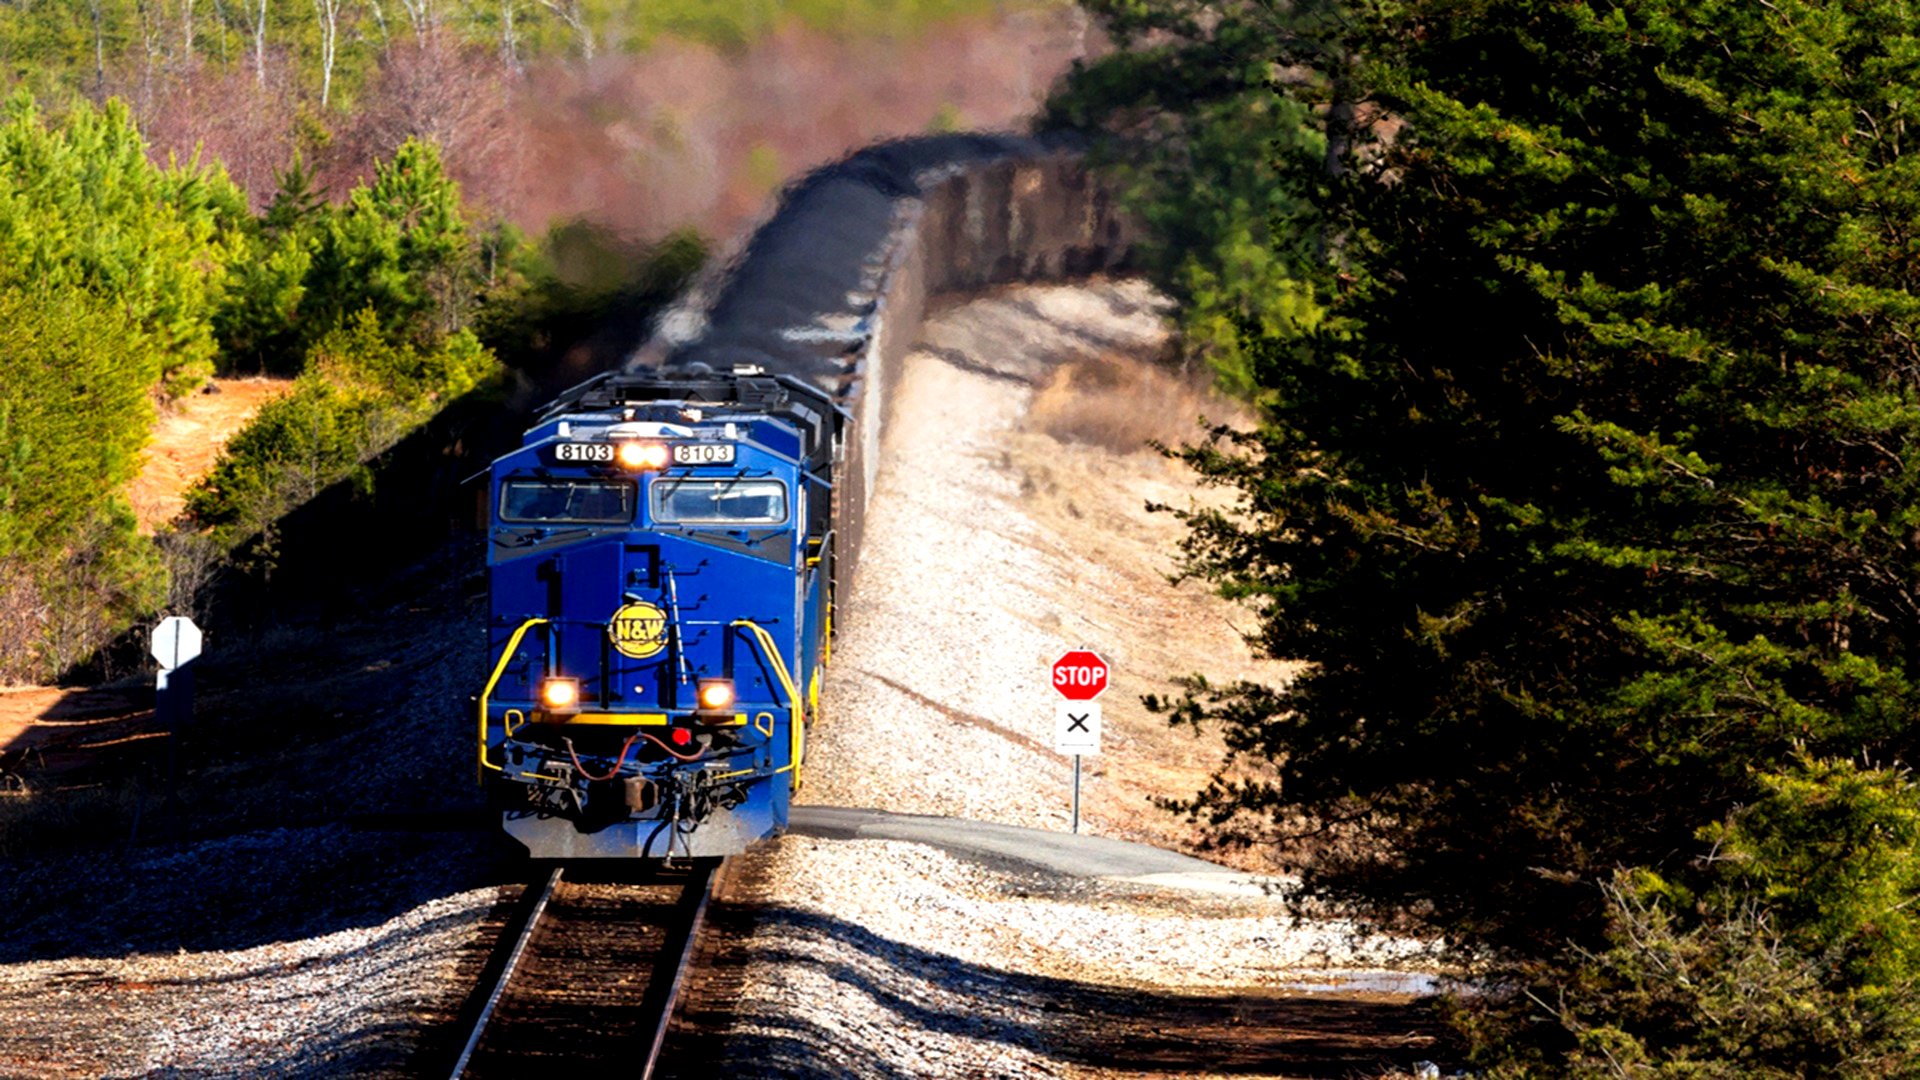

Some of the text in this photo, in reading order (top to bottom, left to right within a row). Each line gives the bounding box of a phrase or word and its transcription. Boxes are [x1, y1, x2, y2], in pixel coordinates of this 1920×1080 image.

[561, 443, 609, 461] 8103
[680, 445, 728, 461] 8103
[616, 619, 665, 640] N&W
[1055, 665, 1105, 686] STOP
